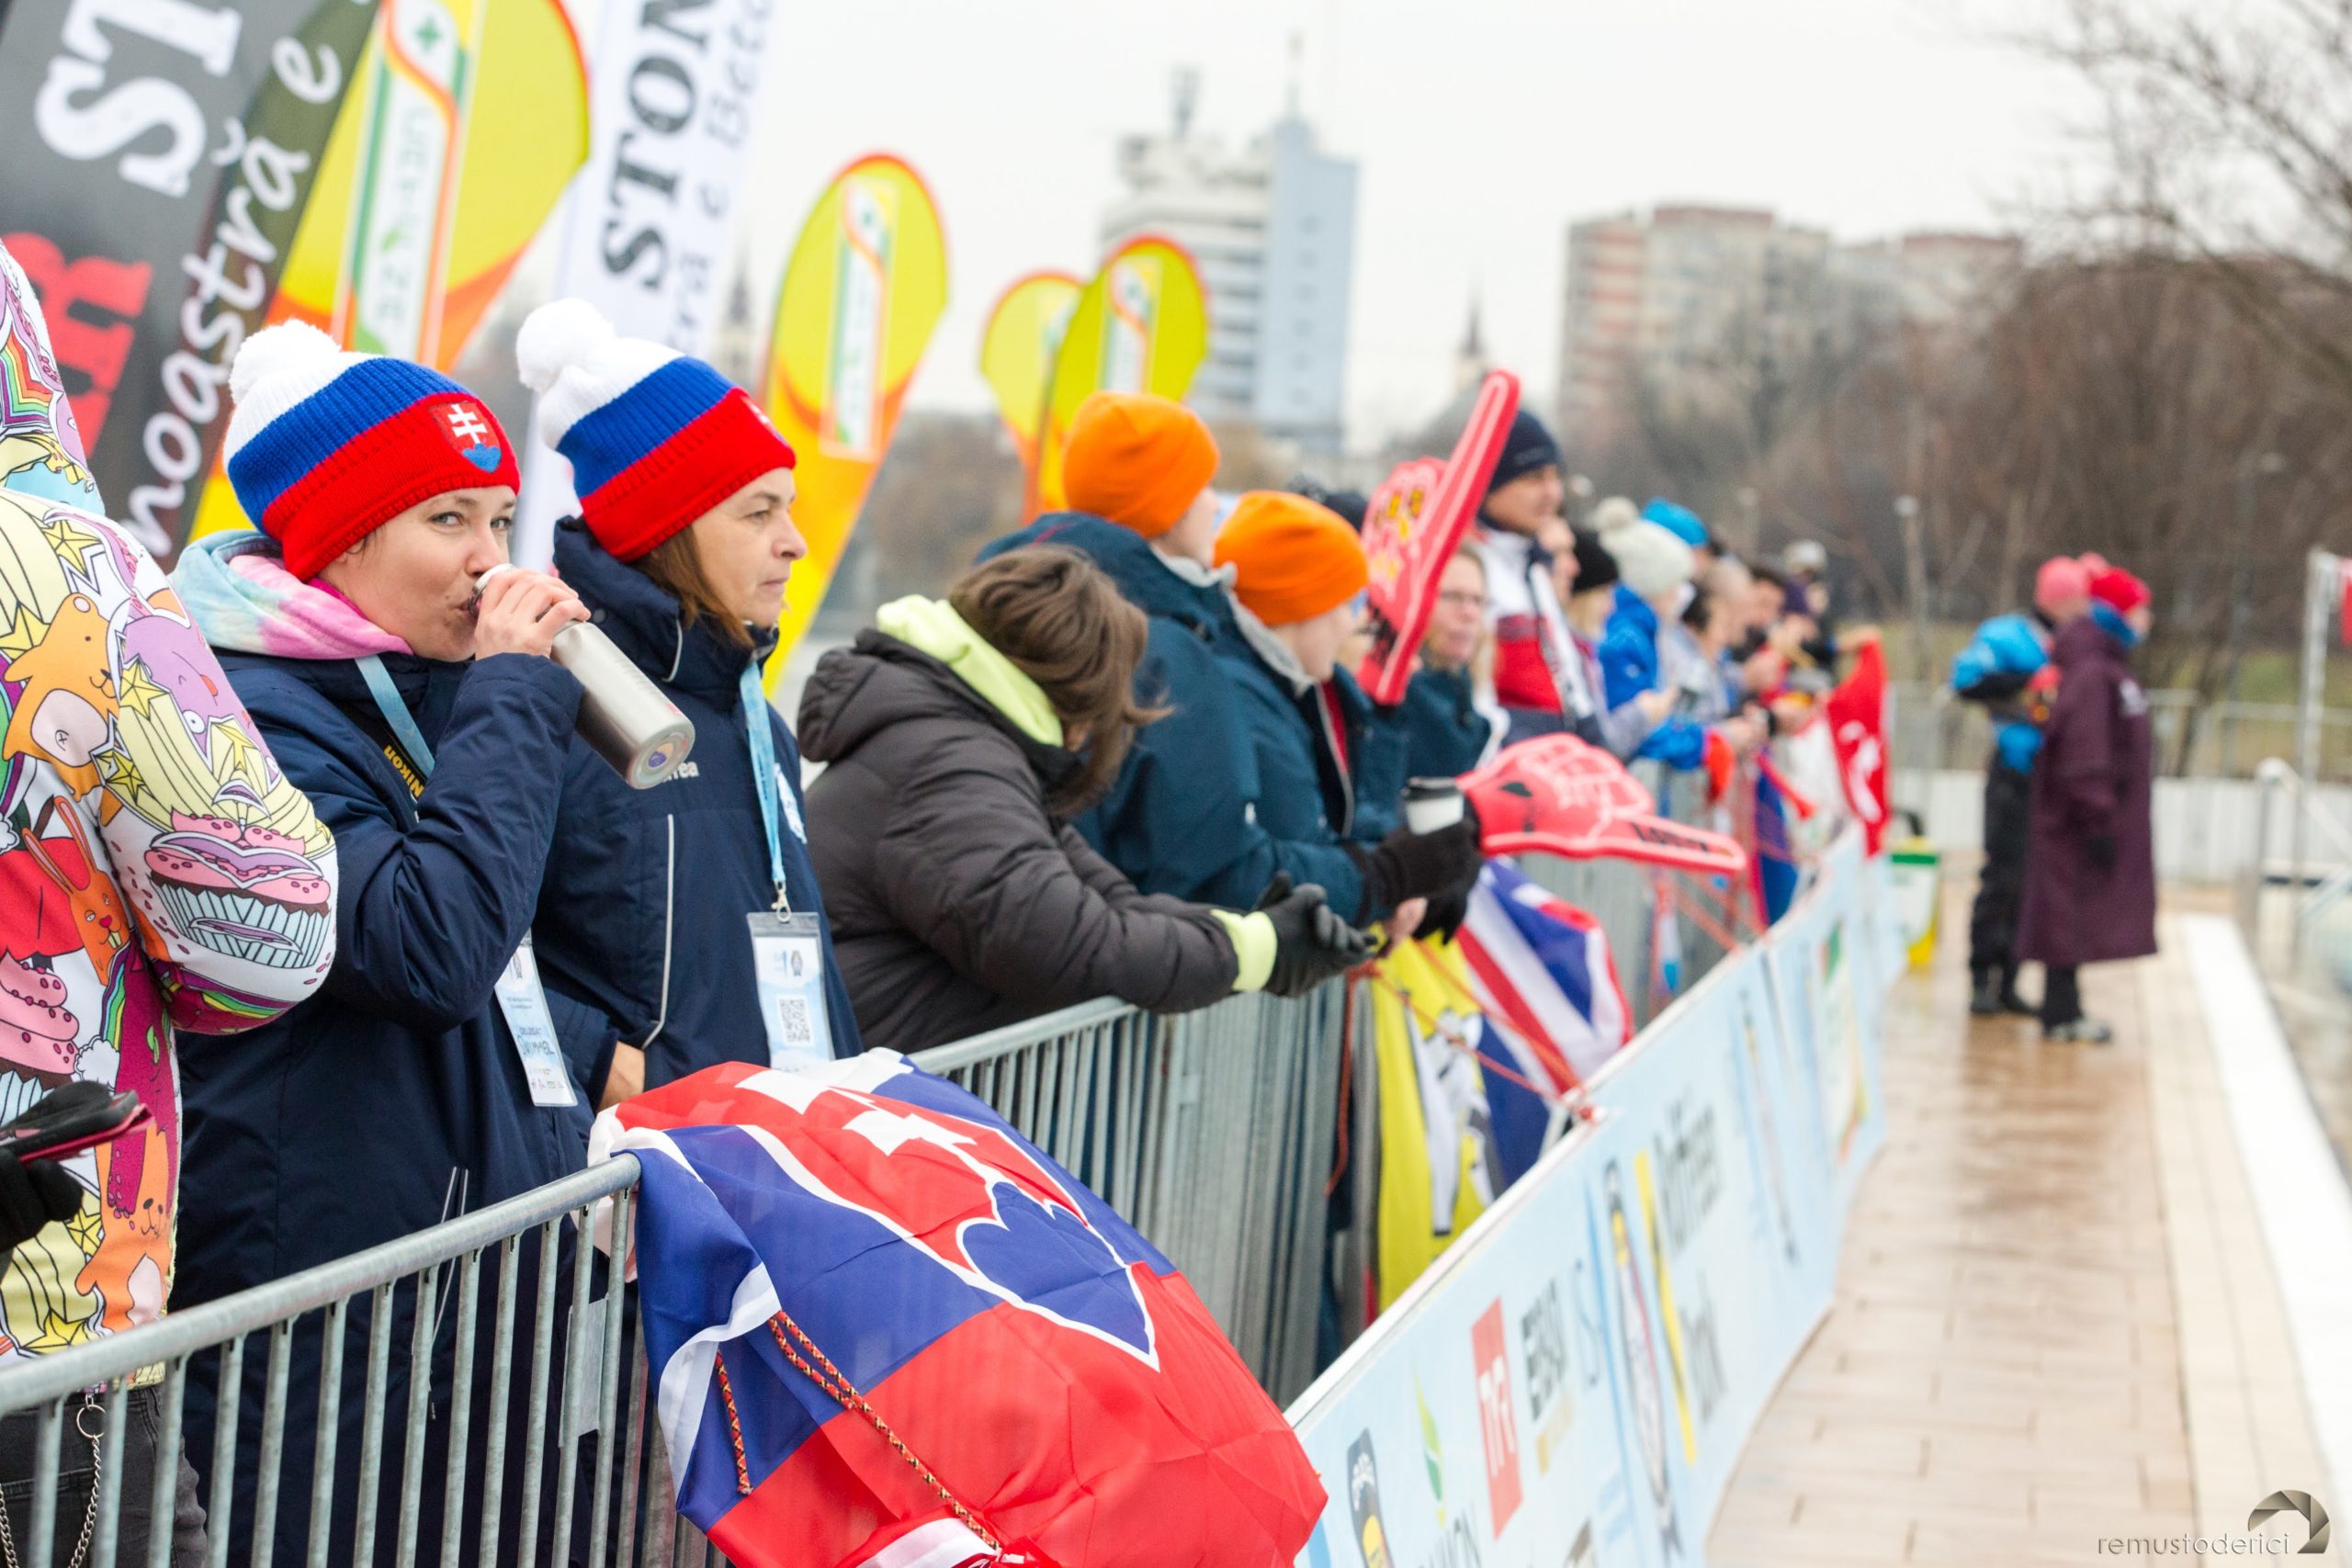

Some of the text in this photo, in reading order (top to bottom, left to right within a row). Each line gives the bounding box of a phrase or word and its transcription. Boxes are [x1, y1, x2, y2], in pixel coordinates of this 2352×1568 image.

[119, 37, 342, 557] noastră e
[384, 745, 424, 797] Nikon
